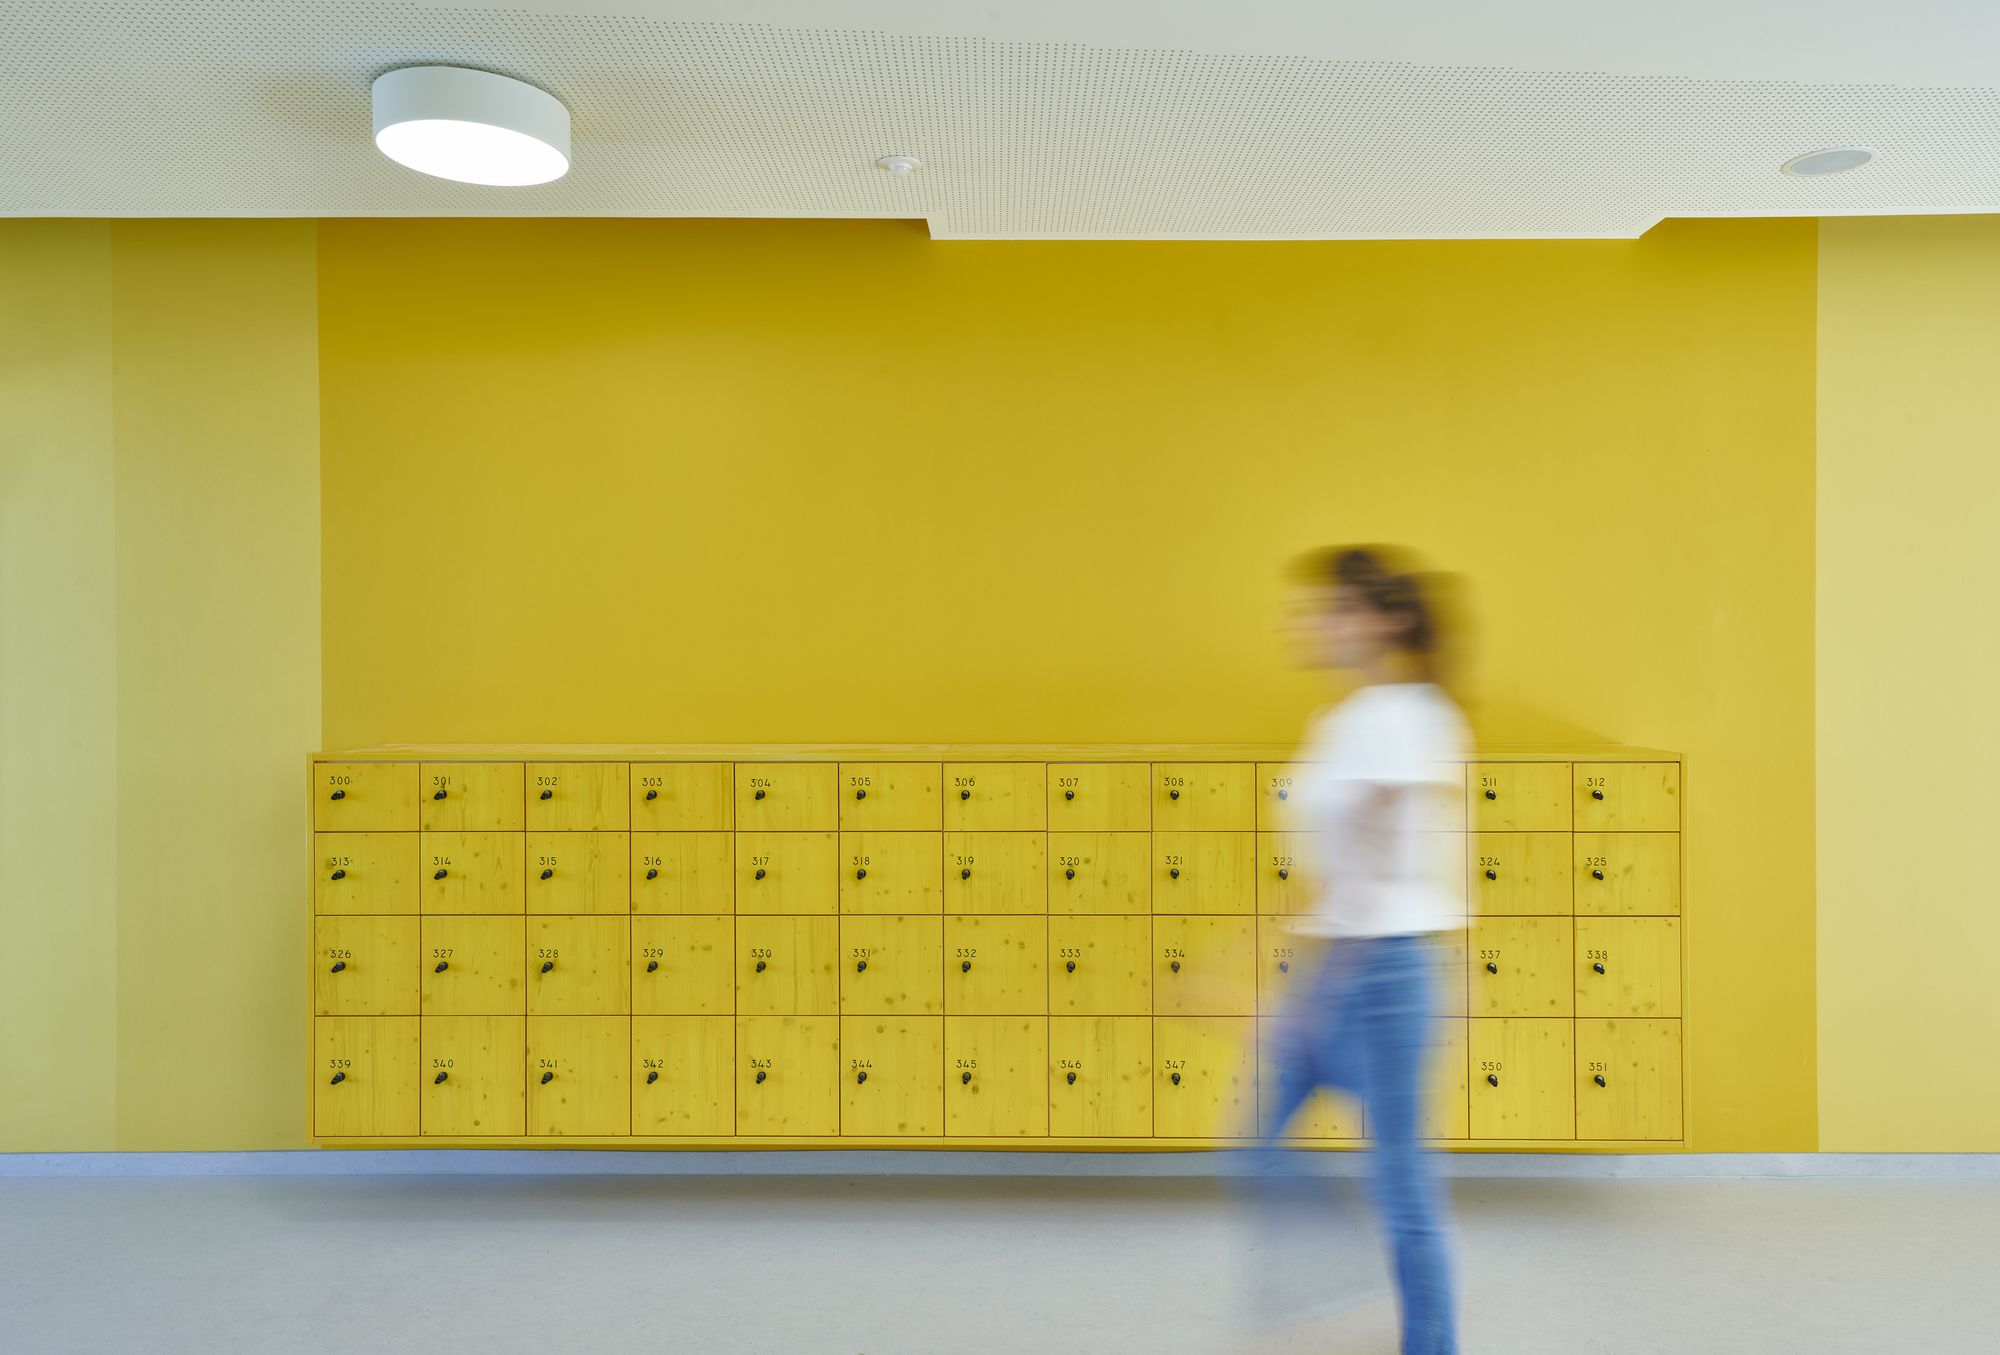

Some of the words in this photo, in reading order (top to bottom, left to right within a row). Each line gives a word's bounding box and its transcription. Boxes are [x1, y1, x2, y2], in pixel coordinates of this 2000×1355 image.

[329, 776, 350, 785] 300
[433, 776, 451, 786] 301
[537, 776, 558, 786] 302
[641, 777, 663, 787] 303
[750, 778, 771, 788] 304
[850, 777, 871, 787] 305
[954, 777, 976, 787] 306
[1058, 777, 1079, 787] 307
[1163, 777, 1184, 787] 308
[1271, 777, 1293, 788] 309
[1481, 777, 1497, 787] 311
[1587, 777, 1605, 787] 312
[331, 857, 350, 867] 313
[433, 856, 451, 866] 314
[539, 856, 557, 866] 315
[643, 856, 662, 866] 316
[751, 856, 770, 866] 317
[852, 856, 870, 866] 318
[956, 856, 974, 866] 319
[1059, 856, 1080, 866] 320
[1165, 856, 1183, 866] 321
[1272, 856, 1293, 866] 322
[1479, 857, 1500, 867] 324
[1585, 857, 1607, 867] 325
[330, 949, 352, 959] 326
[433, 949, 453, 959] 327
[538, 949, 559, 959] 328
[642, 948, 664, 958] 329
[751, 948, 772, 958] 330
[852, 948, 871, 958] 331
[956, 948, 977, 958] 332
[1060, 948, 1081, 958] 333
[1164, 948, 1185, 958] 334
[1272, 948, 1294, 958] 335
[1480, 950, 1501, 960] 337
[1587, 950, 1608, 960] 338
[329, 1059, 351, 1069] 339
[432, 1059, 454, 1069] 340
[539, 1059, 558, 1069] 341
[642, 1059, 664, 1069] 342
[750, 1059, 772, 1069] 343
[851, 1059, 873, 1069] 344
[956, 1059, 977, 1069] 345
[1060, 1059, 1082, 1069] 346
[1165, 1060, 1185, 1070] 347
[1480, 1062, 1502, 1072] 350
[1588, 1062, 1607, 1072] 351
